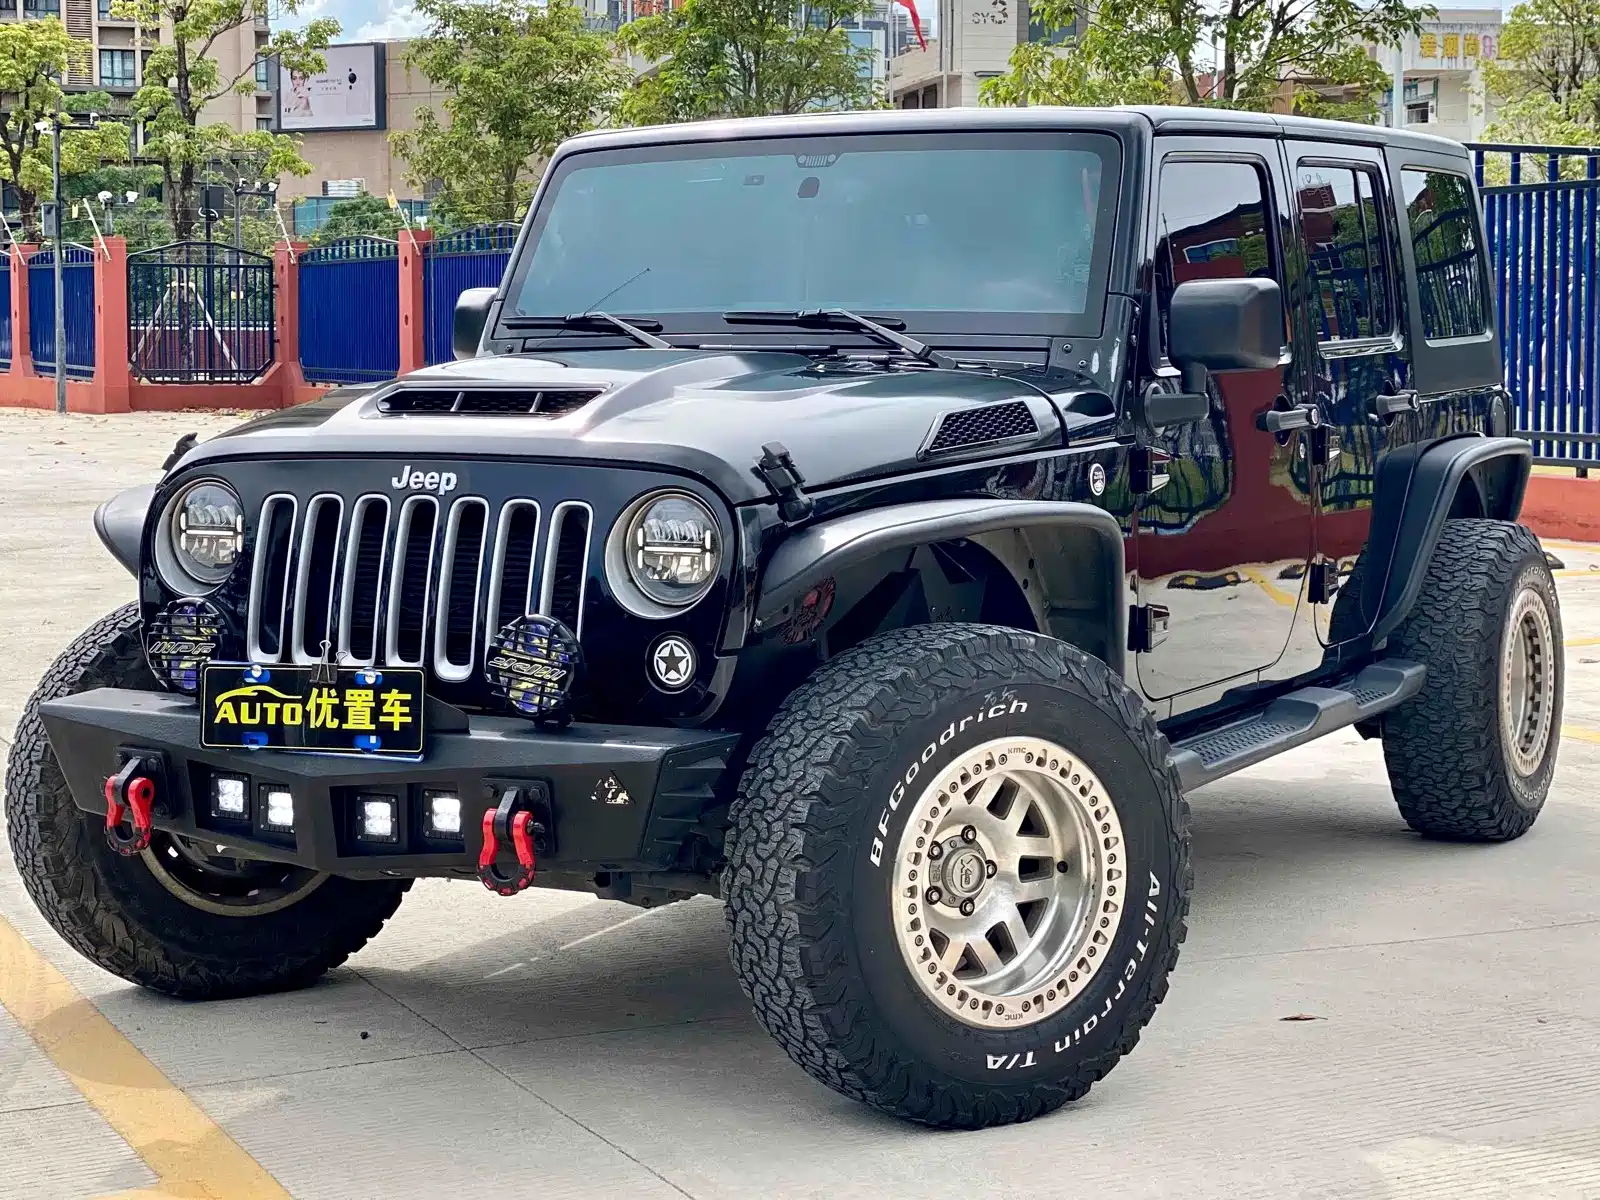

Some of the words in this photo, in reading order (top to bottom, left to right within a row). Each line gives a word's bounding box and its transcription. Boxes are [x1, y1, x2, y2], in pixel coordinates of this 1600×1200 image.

[391, 465, 457, 496] Jeep
[870, 700, 1028, 867] BFGoodrich
[1054, 871, 1161, 1053] All-Terrain
[986, 1051, 1037, 1070] T/A
